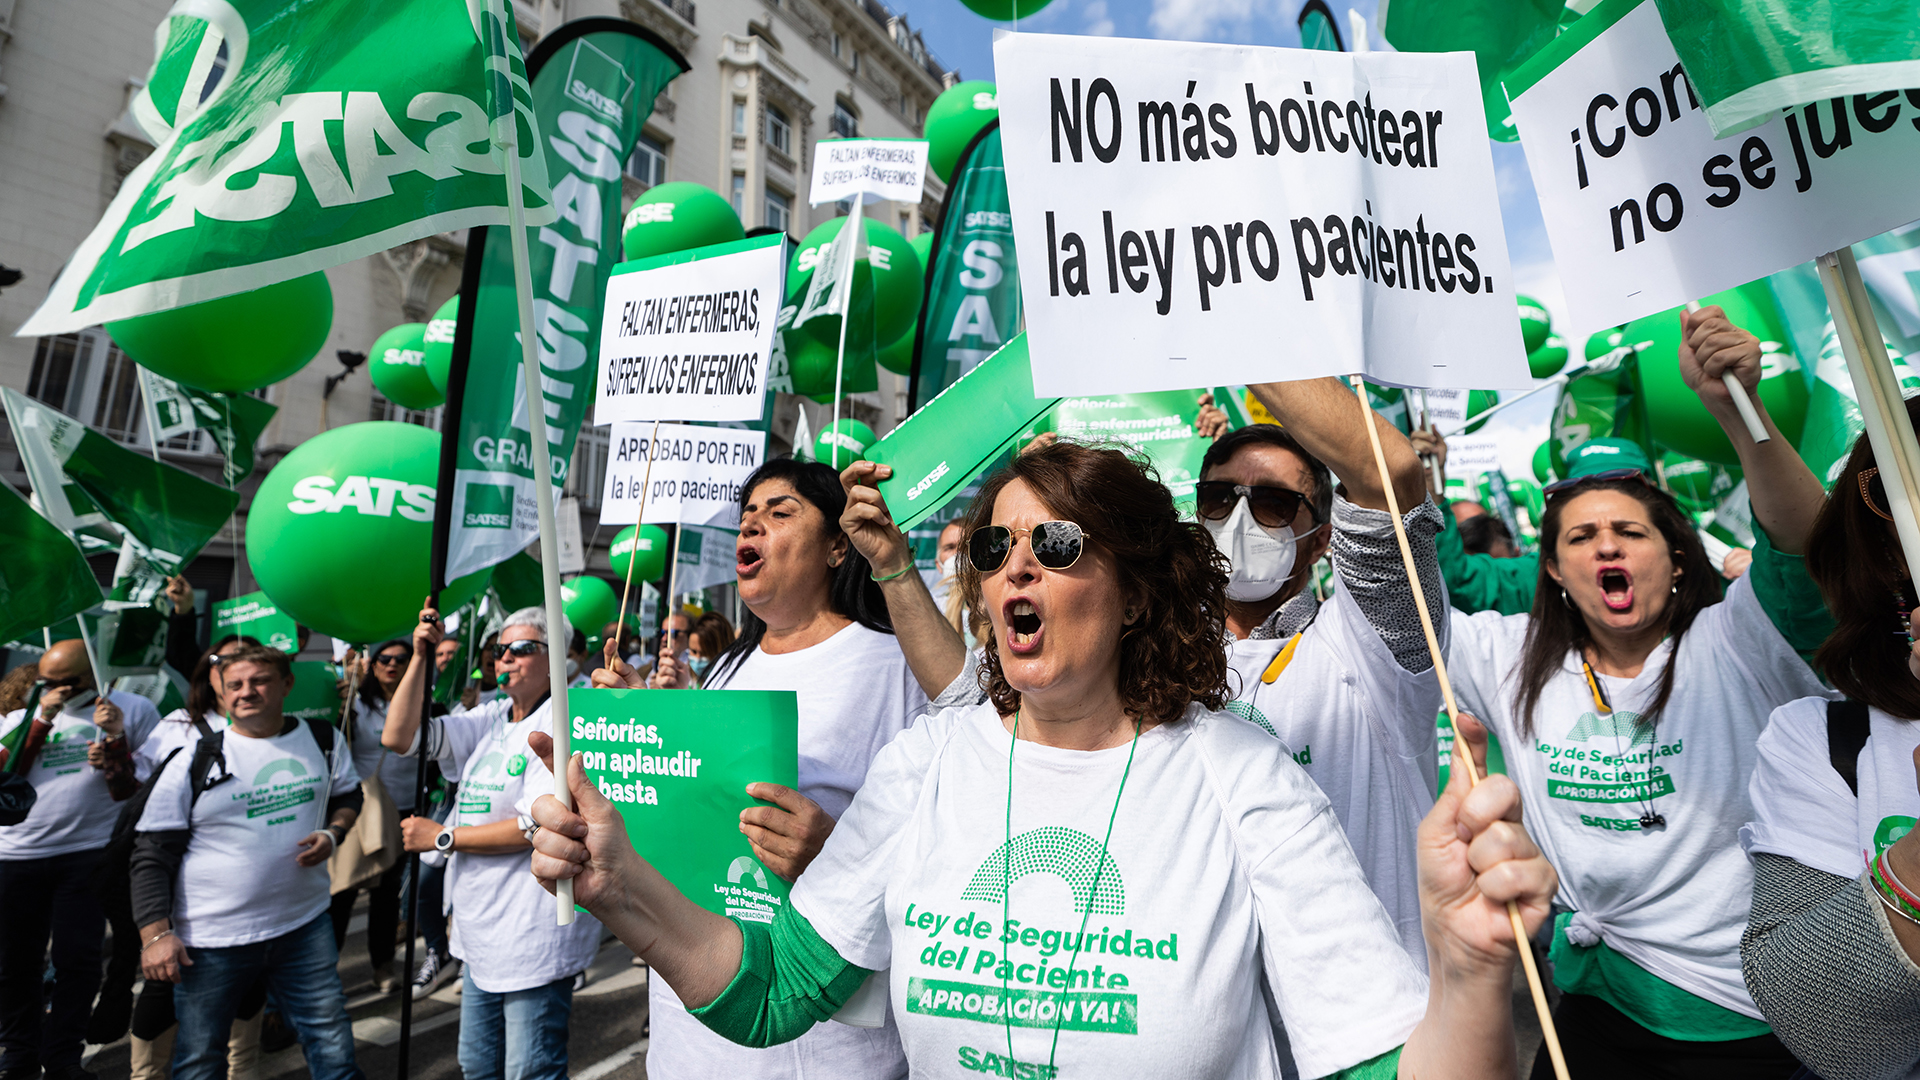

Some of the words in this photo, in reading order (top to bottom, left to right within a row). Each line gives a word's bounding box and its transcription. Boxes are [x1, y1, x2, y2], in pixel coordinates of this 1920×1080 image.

[1050, 78, 1121, 163] NO
[1139, 80, 1237, 162] más
[1246, 82, 1442, 168] boicotear
[830, 148, 860, 163] FALTAN
[861, 147, 916, 165] ENFERMERAS,
[823, 170, 853, 185] SUFREN
[855, 165, 870, 179] LOS
[871, 167, 918, 186] ENFERMOS.
[1610, 182, 1684, 252] no
[1703, 137, 1776, 207] se
[1046, 211, 1090, 297] la
[1103, 211, 1175, 315] ley
[1193, 220, 1279, 311] pro
[1291, 200, 1494, 301] pacientes.
[619, 297, 667, 338] FALTAN
[665, 288, 760, 338] ENFERMERAS,
[947, 240, 1004, 377] SAT
[383, 348, 425, 366] SAT
[607, 356, 651, 397] SUFREN
[648, 354, 678, 394] LOS
[677, 352, 758, 395] ENFERMOS.
[1090, 414, 1181, 430] enfermeras
[617, 437, 693, 462] APROBAD
[696, 441, 728, 465] POR
[732, 443, 756, 467] FIN
[611, 475, 624, 499] la
[628, 475, 649, 506] ley
[652, 479, 676, 505] pro
[680, 477, 741, 503] paciente
[907, 461, 950, 501] SATSE
[287, 475, 437, 522] SATS
[465, 513, 509, 527] SATSE
[572, 716, 663, 749] Señorías,
[572, 750, 606, 770] on
[610, 748, 701, 779] aplaudir
[1535, 738, 1562, 759] Ley
[1564, 747, 1586, 760] de
[1549, 761, 1575, 777] del
[1580, 765, 1664, 782] Paciente
[599, 775, 658, 805] basta
[1555, 784, 1641, 799] APROBACIÓN
[1645, 780, 1665, 797] YA!
[1580, 814, 1641, 831] SATSE
[714, 884, 729, 896] Ley
[730, 886, 741, 895] de
[742, 888, 781, 906] Seguridad
[726, 896, 739, 906] del
[740, 898, 774, 912] Paciente
[905, 903, 950, 937] Ley
[954, 911, 992, 940] de
[997, 919, 1179, 963] Seguridad
[920, 941, 969, 971] del
[972, 947, 1130, 990] Paciente
[918, 988, 1075, 1023] APROBACIÓN
[1075, 1001, 1121, 1025] YA!
[957, 1046, 1060, 1080] SATSE
